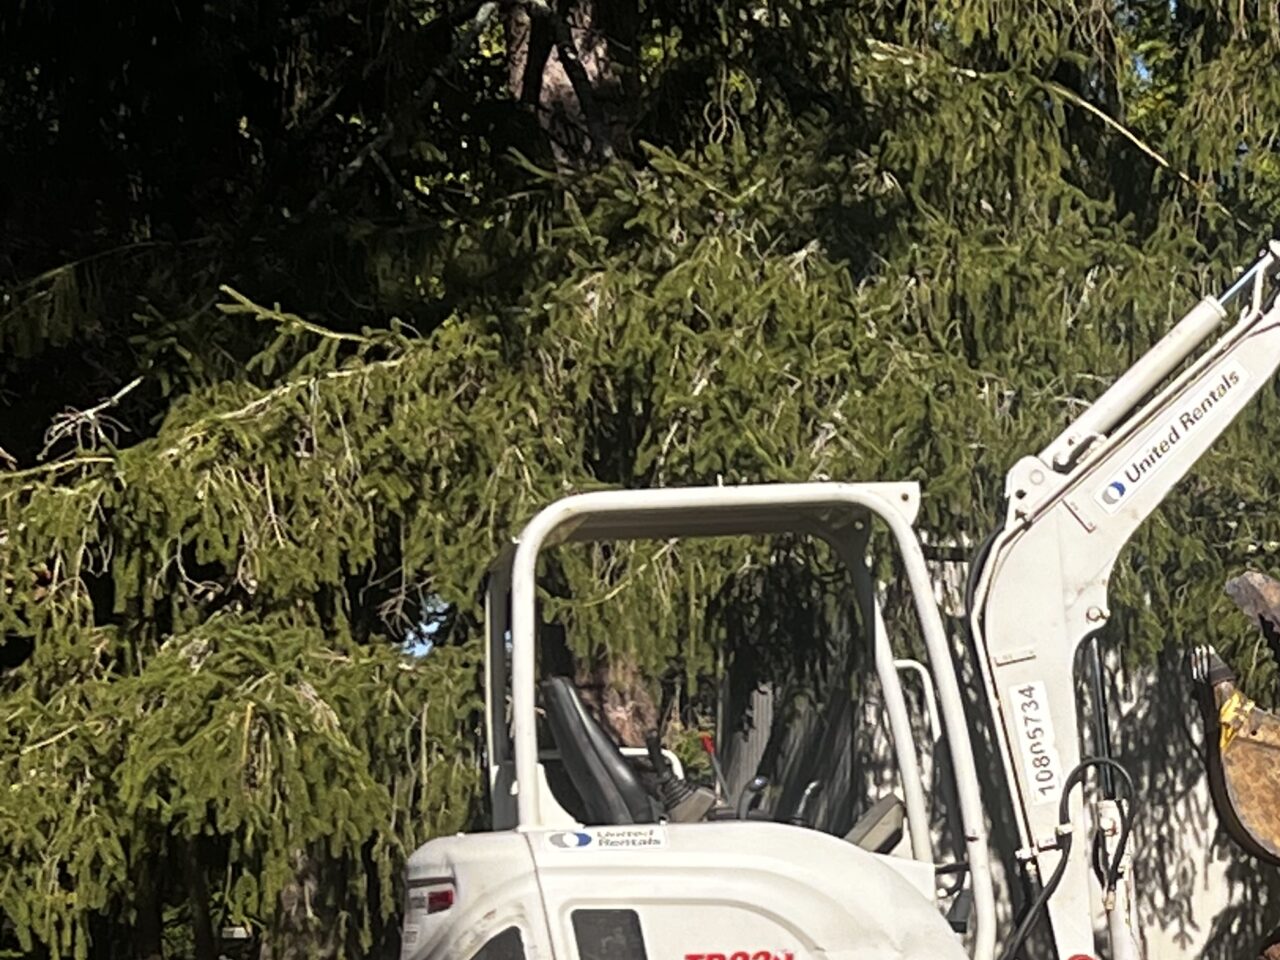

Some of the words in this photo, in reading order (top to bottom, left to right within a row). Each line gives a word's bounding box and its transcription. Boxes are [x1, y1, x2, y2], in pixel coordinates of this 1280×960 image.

[1124, 425, 1181, 484] United
[1178, 370, 1240, 432] Rentals
[1018, 684, 1055, 797] 10805734
